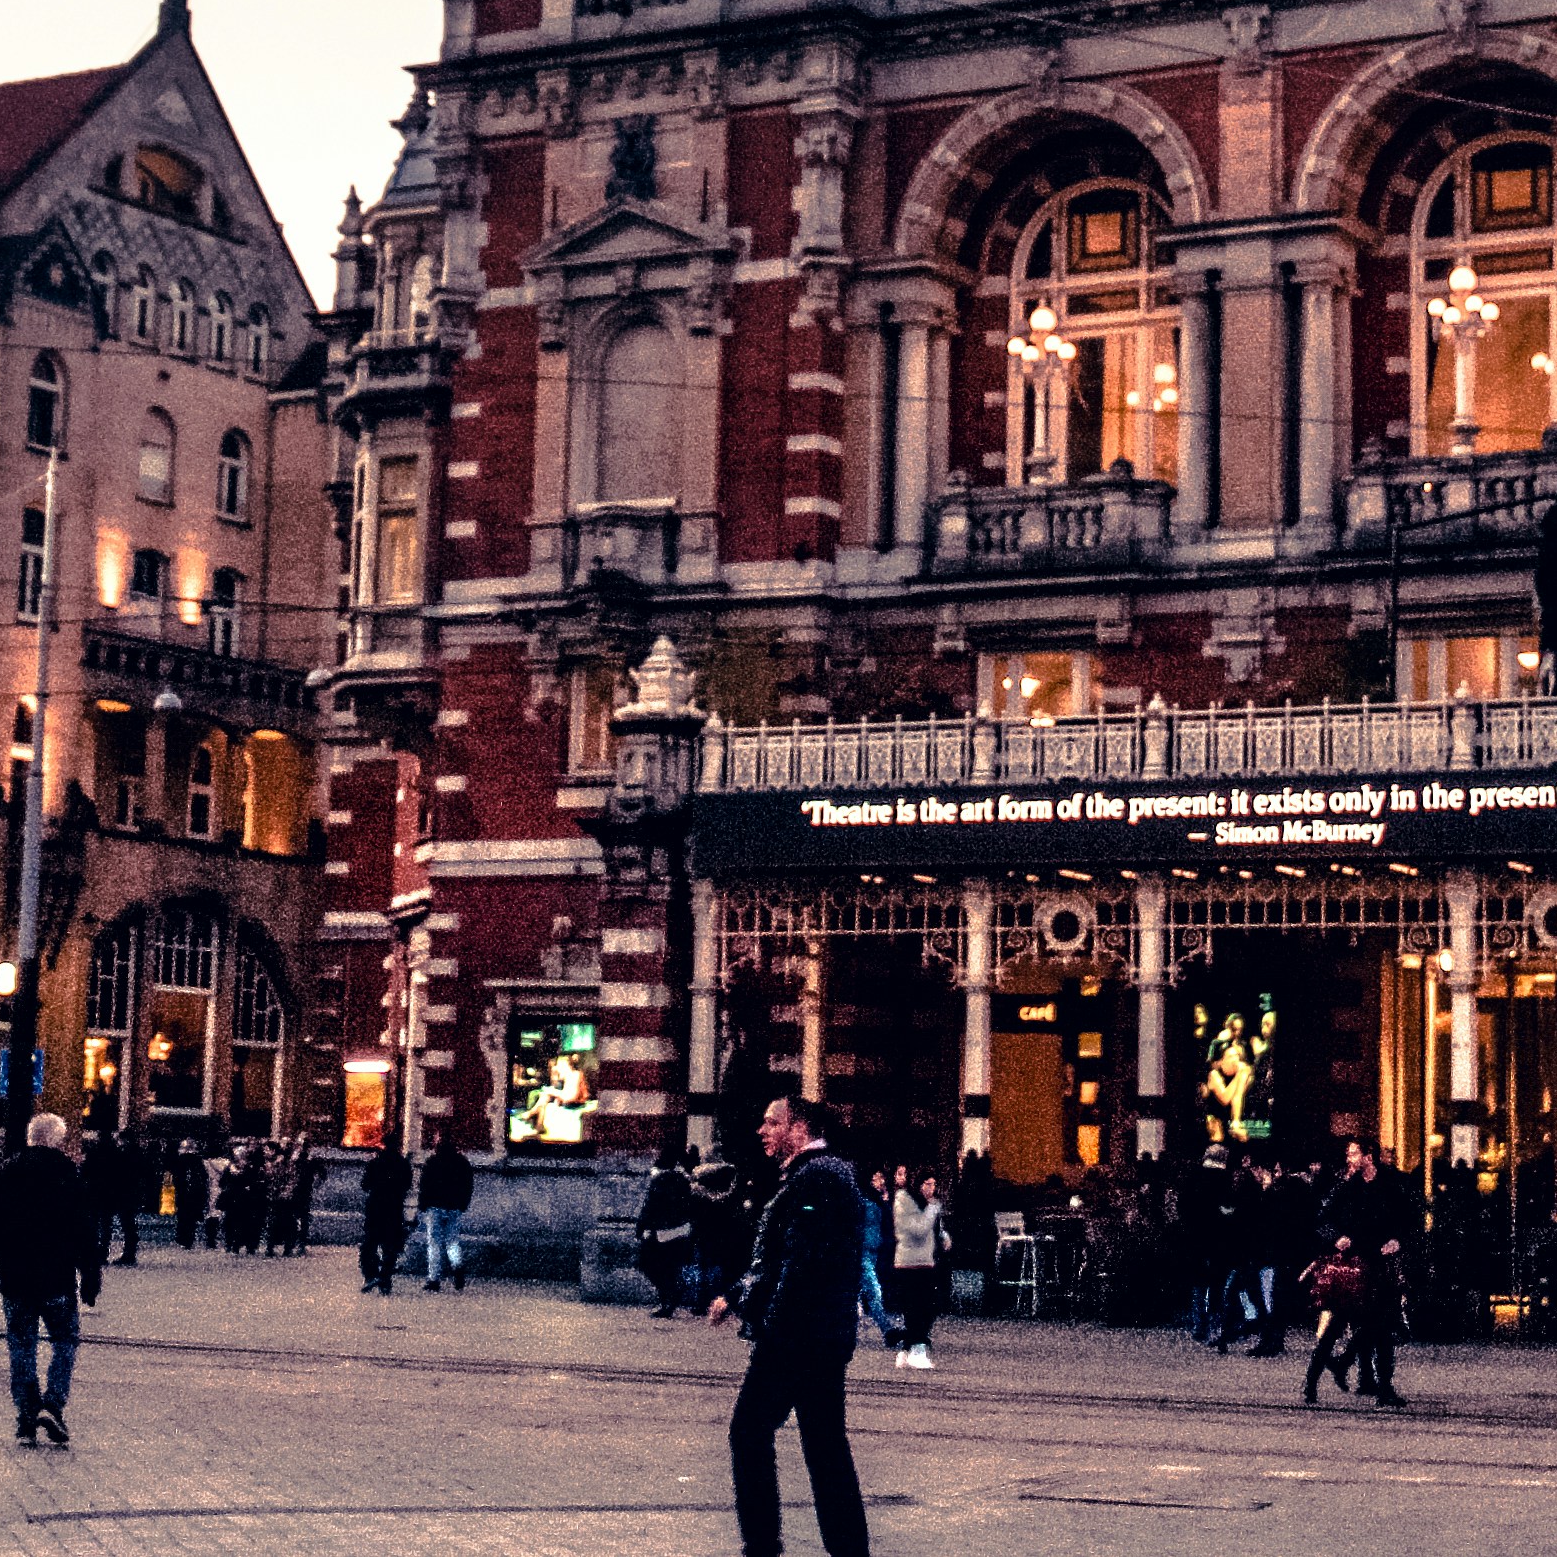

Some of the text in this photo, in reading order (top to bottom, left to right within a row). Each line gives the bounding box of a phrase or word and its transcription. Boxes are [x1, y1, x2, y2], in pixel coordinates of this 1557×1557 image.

[895, 798, 917, 825] is
[919, 796, 957, 824] the
[960, 797, 994, 824] art
[997, 794, 1054, 823] form
[1056, 792, 1085, 821] of
[1085, 792, 1126, 820] the
[1127, 791, 1228, 826] present:
[1230, 788, 1251, 817] it
[1253, 787, 1327, 815] exists
[1329, 783, 1387, 819] only
[1390, 783, 1418, 813] in
[1422, 781, 1465, 812] the
[1214, 821, 1281, 846] Simon
[1282, 819, 1388, 848] McBurney
